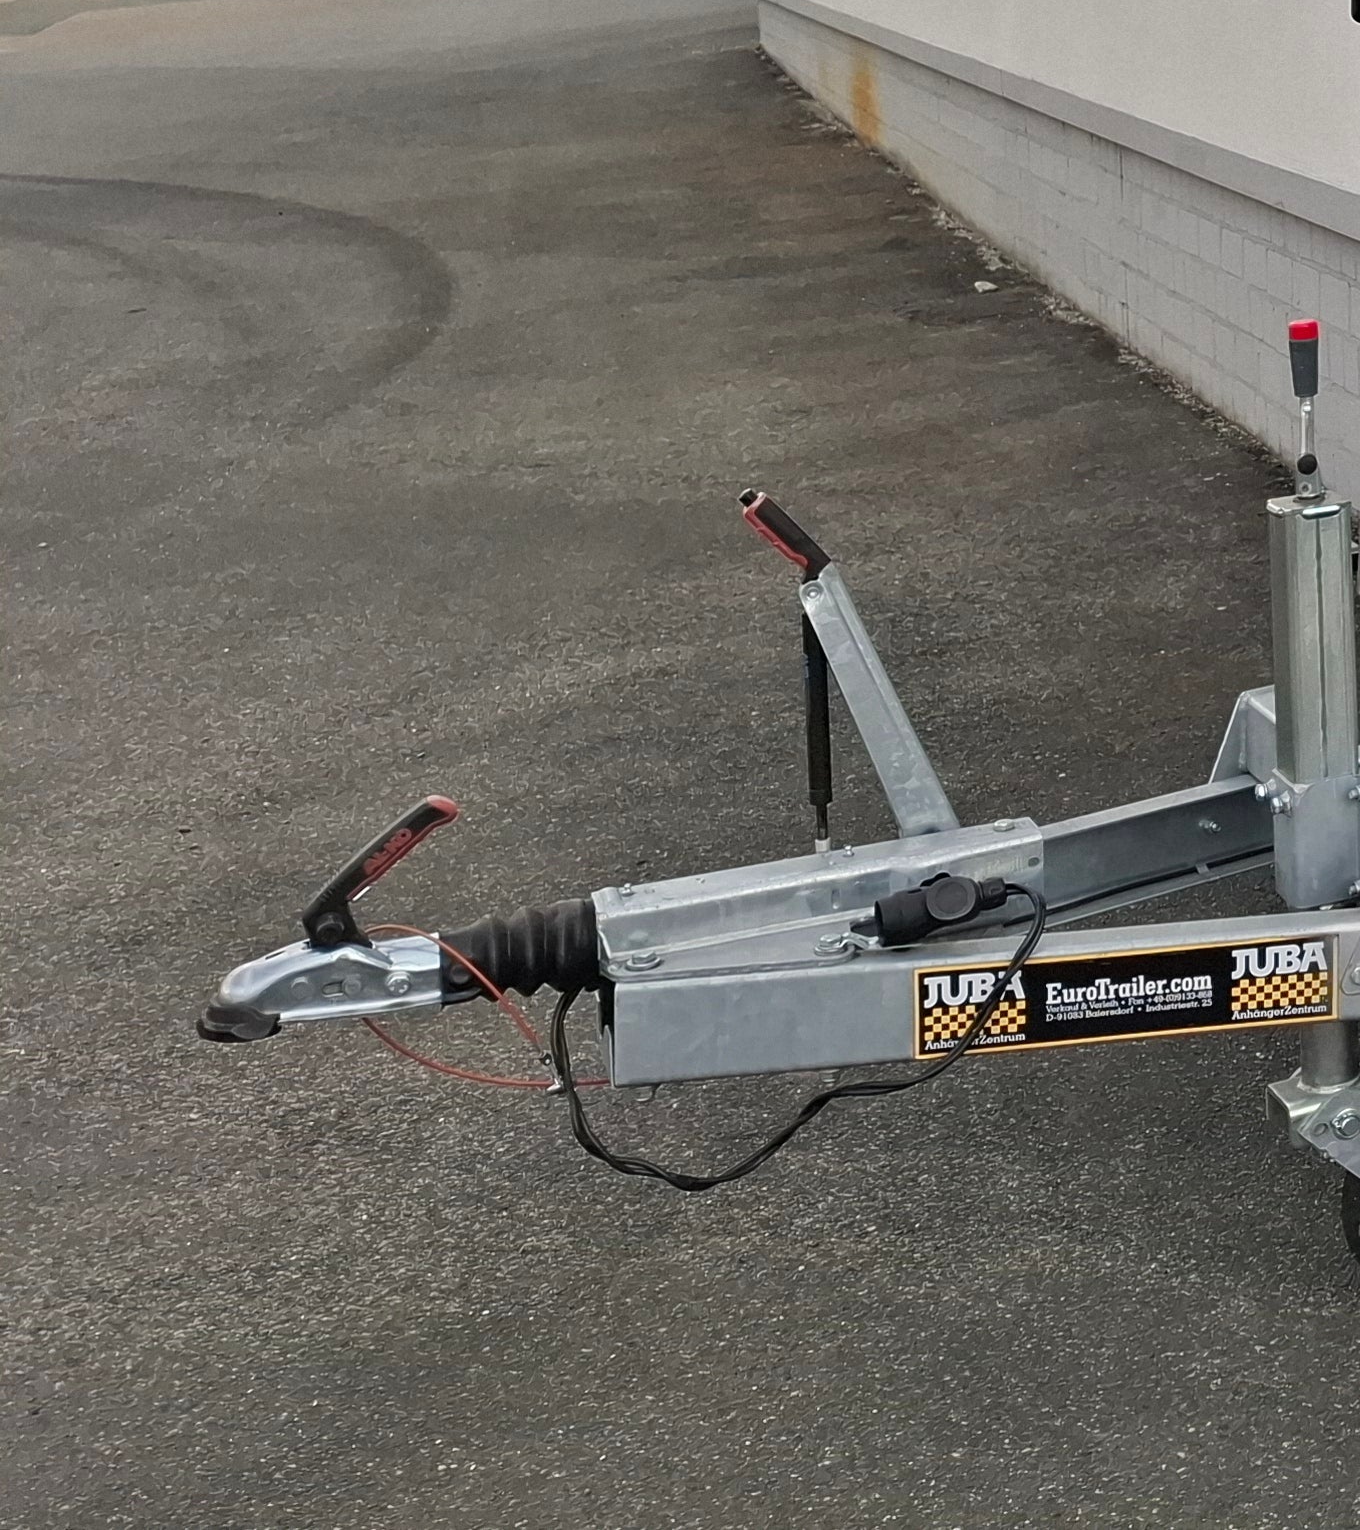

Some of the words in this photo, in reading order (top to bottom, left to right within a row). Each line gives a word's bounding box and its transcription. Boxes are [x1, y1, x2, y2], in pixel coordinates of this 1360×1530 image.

[1231, 941, 1328, 981] JUBA
[924, 970, 1026, 1009] JUBA
[1045, 975, 1213, 1005] EuroTrailer.com
[1045, 1002, 1079, 1014] Verkauf
[1089, 999, 1119, 1009] Verleih
[1045, 1011, 1084, 1022] D-91083
[1085, 1006, 1134, 1019] Baiersdorf
[1145, 1001, 1200, 1013] Industriestr.
[1201, 998, 1213, 1007] 25
[1231, 1005, 1327, 1021] AnhängerZentrum
